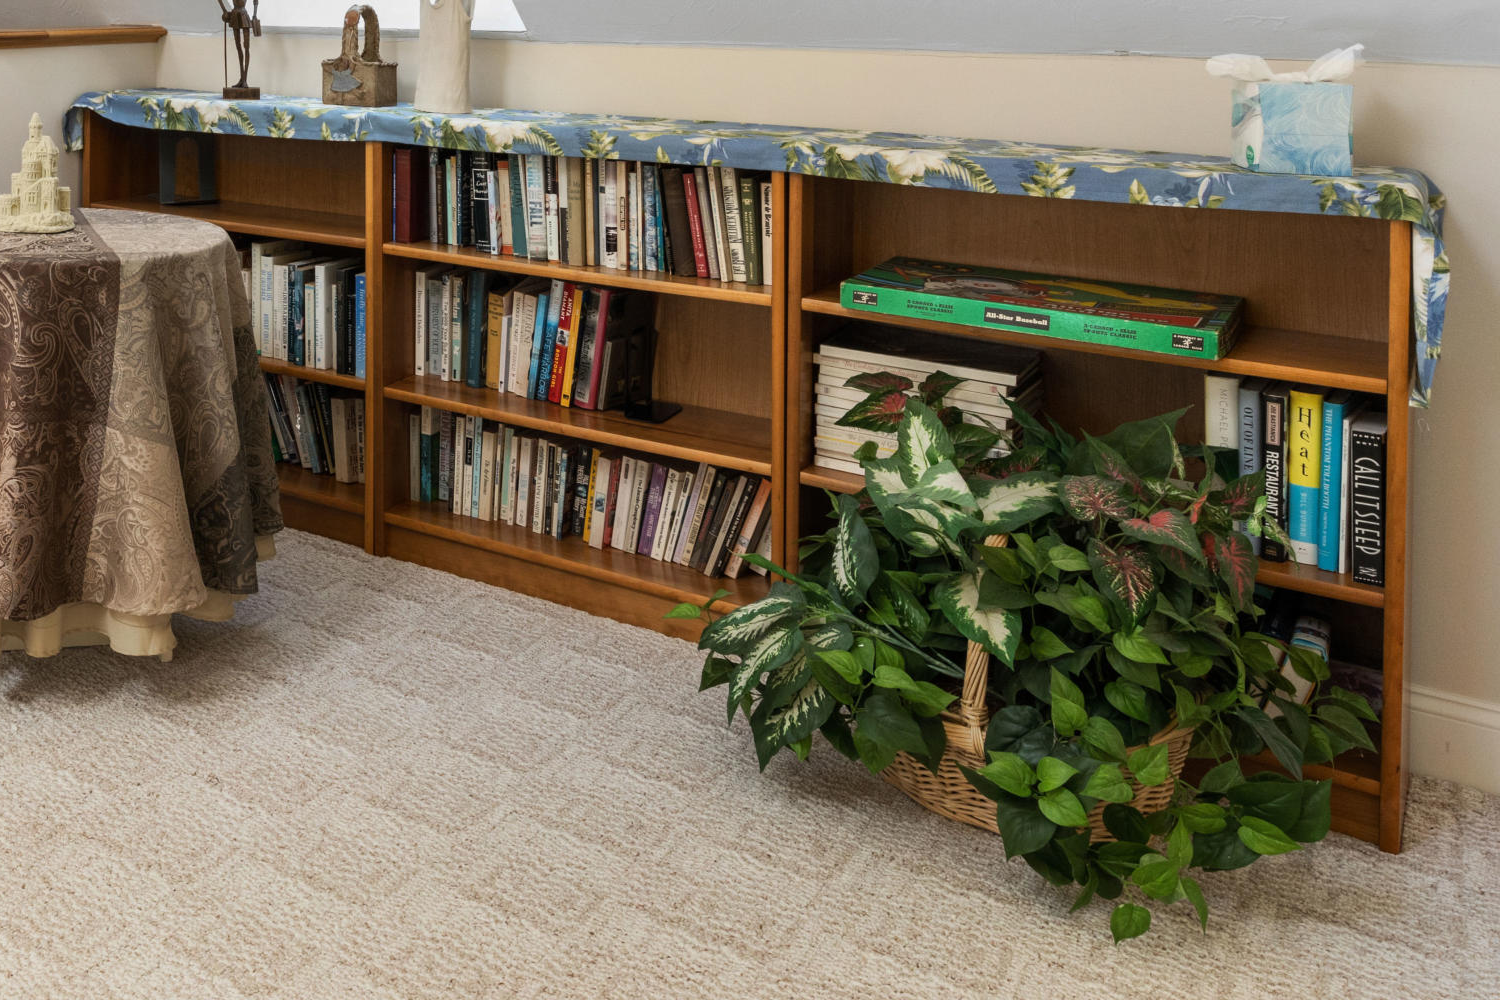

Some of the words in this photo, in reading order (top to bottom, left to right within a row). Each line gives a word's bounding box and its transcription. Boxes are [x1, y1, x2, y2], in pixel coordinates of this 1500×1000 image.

[529, 201, 544, 227] FALL
[560, 291, 569, 320] DIAMANT
[986, 311, 1015, 322] All-Star
[1015, 314, 1048, 326] Baseball
[544, 326, 552, 350] SAFE
[1219, 388, 1228, 433] MICHAEL
[1242, 407, 1254, 428] OUT
[1325, 409, 1333, 425] THE
[1242, 430, 1254, 444] OF
[1298, 406, 1312, 476] Heat
[1323, 425, 1333, 463] PHANTOM
[1242, 446, 1254, 471] LINE
[1265, 450, 1280, 517] RESTAURANT
[1354, 456, 1381, 489] CALL
[1322, 464, 1331, 509] TOLLBOOTH
[1354, 493, 1381, 510] IT
[1354, 510, 1381, 555] SLEEP
